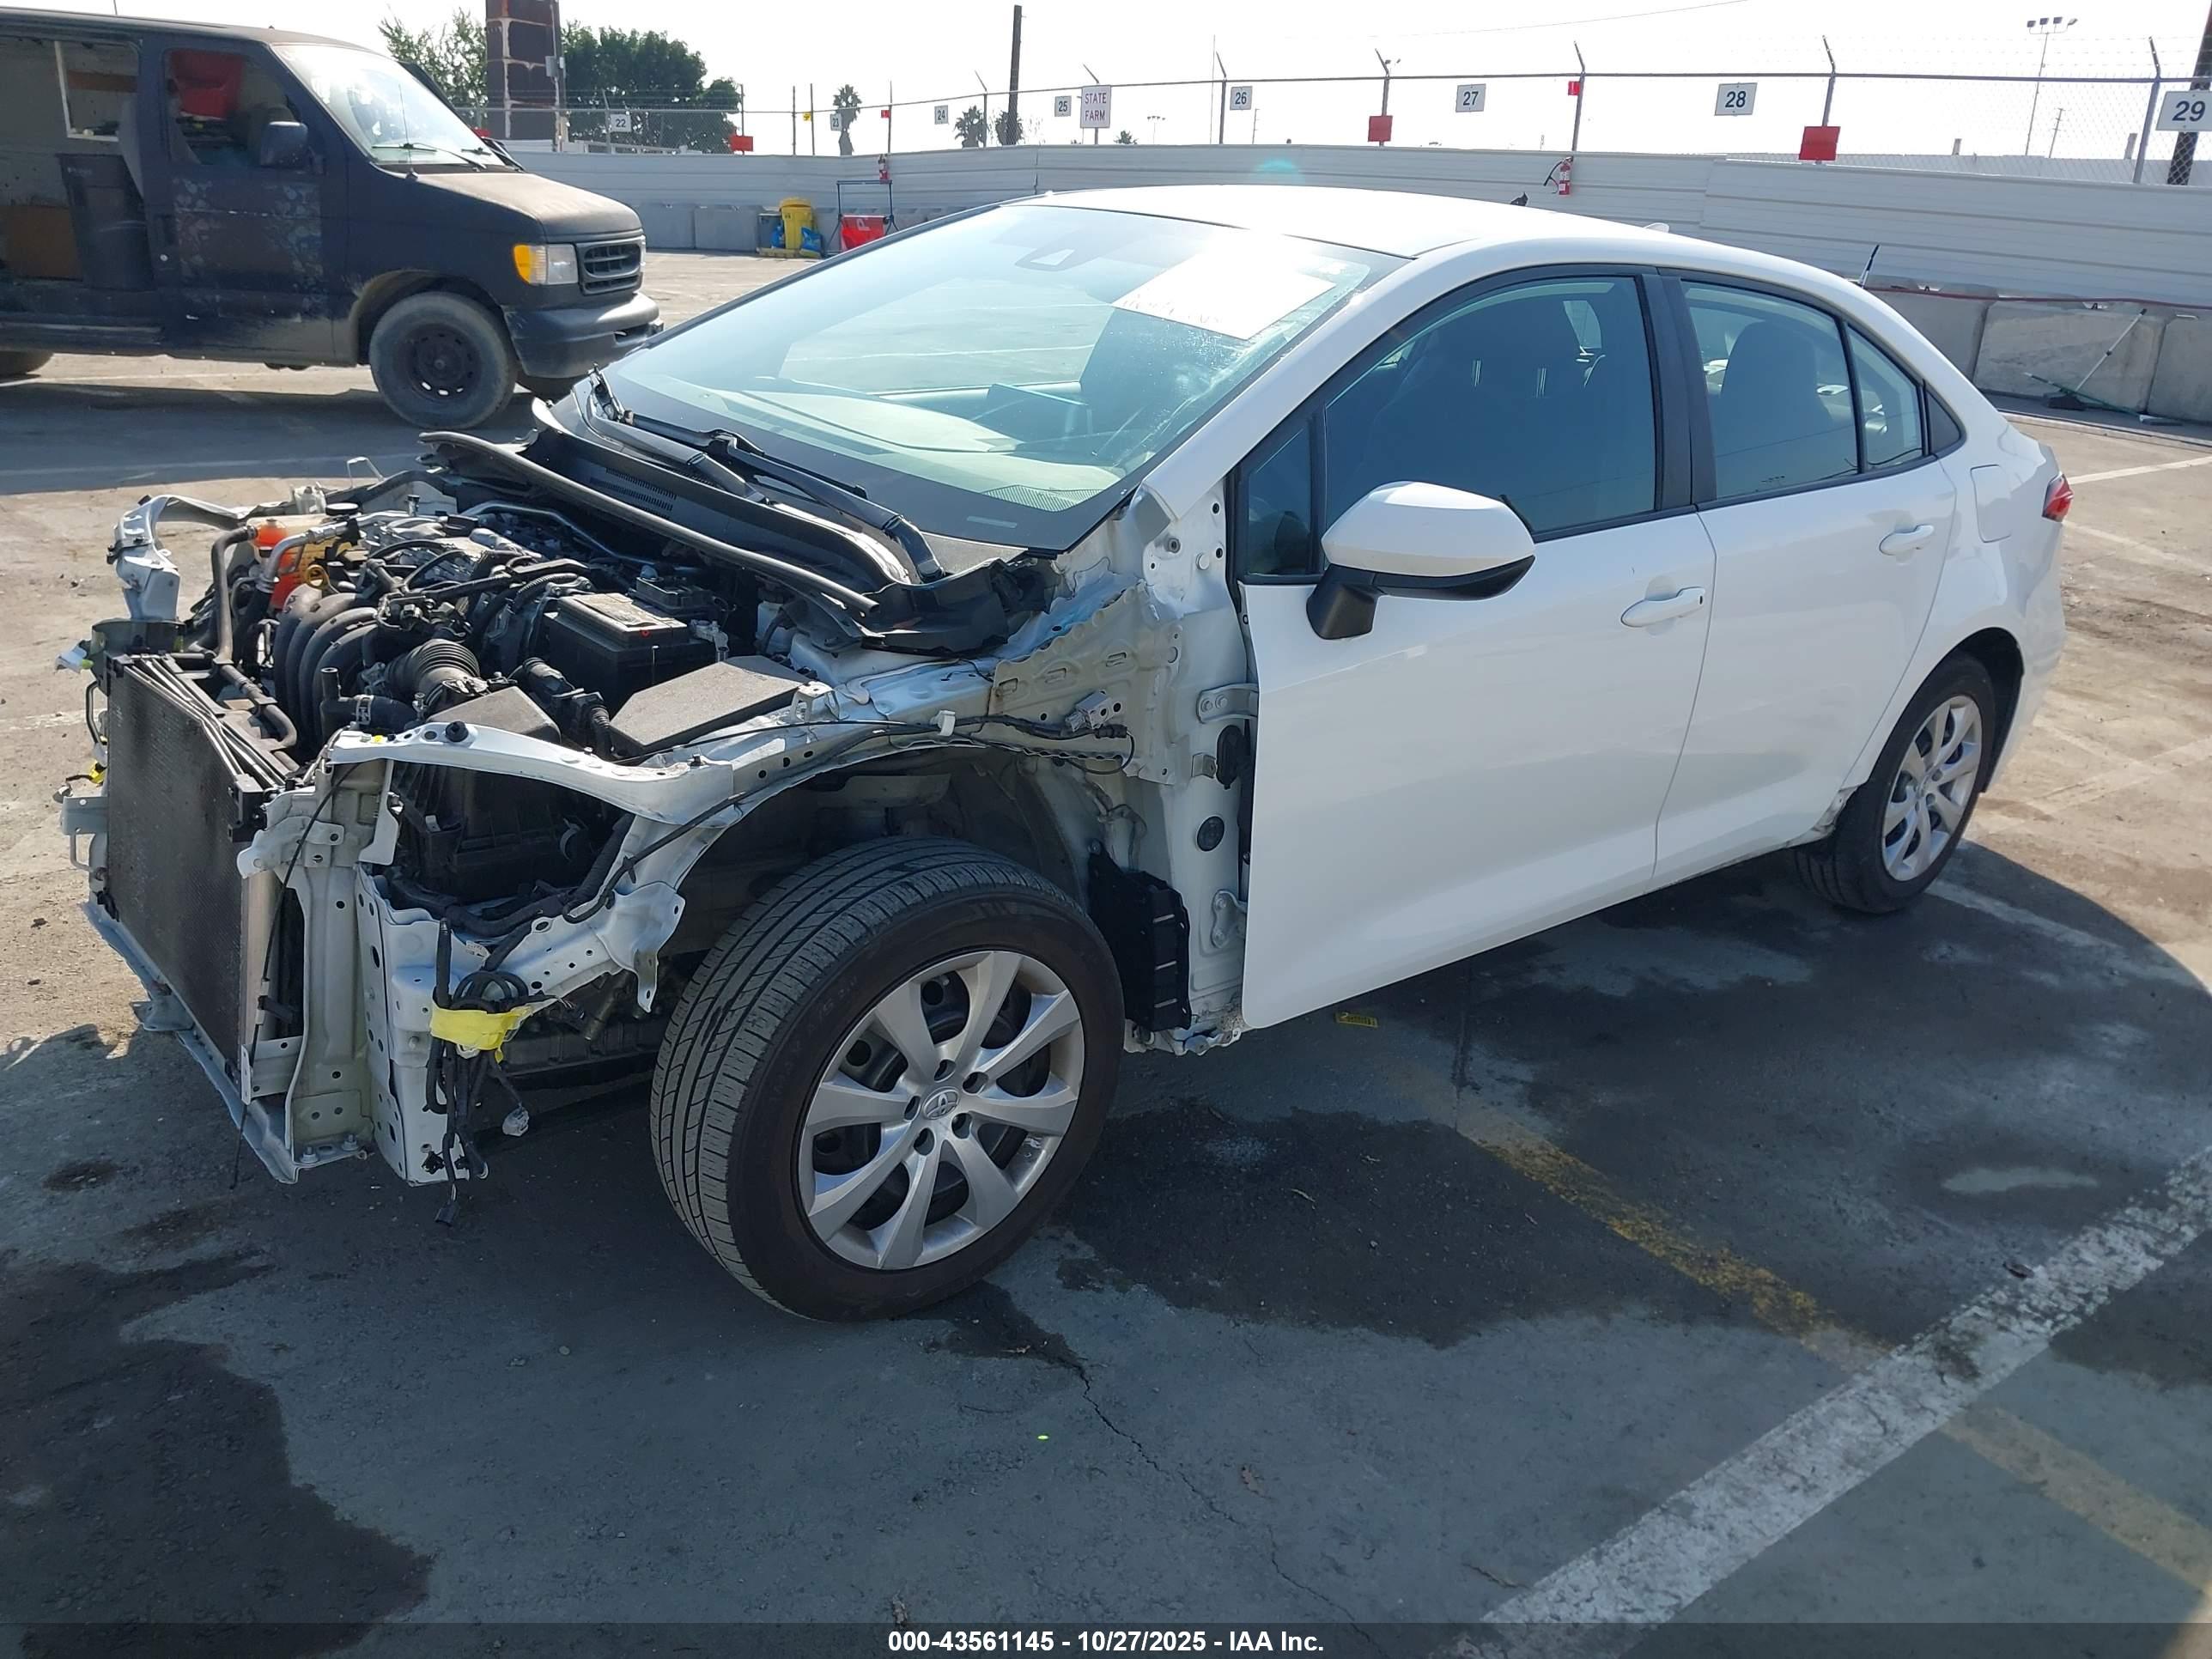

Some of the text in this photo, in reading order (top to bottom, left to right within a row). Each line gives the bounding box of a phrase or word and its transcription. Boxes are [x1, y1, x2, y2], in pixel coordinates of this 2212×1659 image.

[1085, 92, 1107, 104] STATE
[1235, 91, 1247, 104] 26
[1462, 91, 1479, 106] 27
[1724, 91, 1747, 108] 28
[1058, 100, 1068, 112] 25
[2172, 100, 2206, 122] 29
[937, 109, 945, 120] 24
[1085, 110, 1105, 121] FARM
[615, 118, 626, 128] 22
